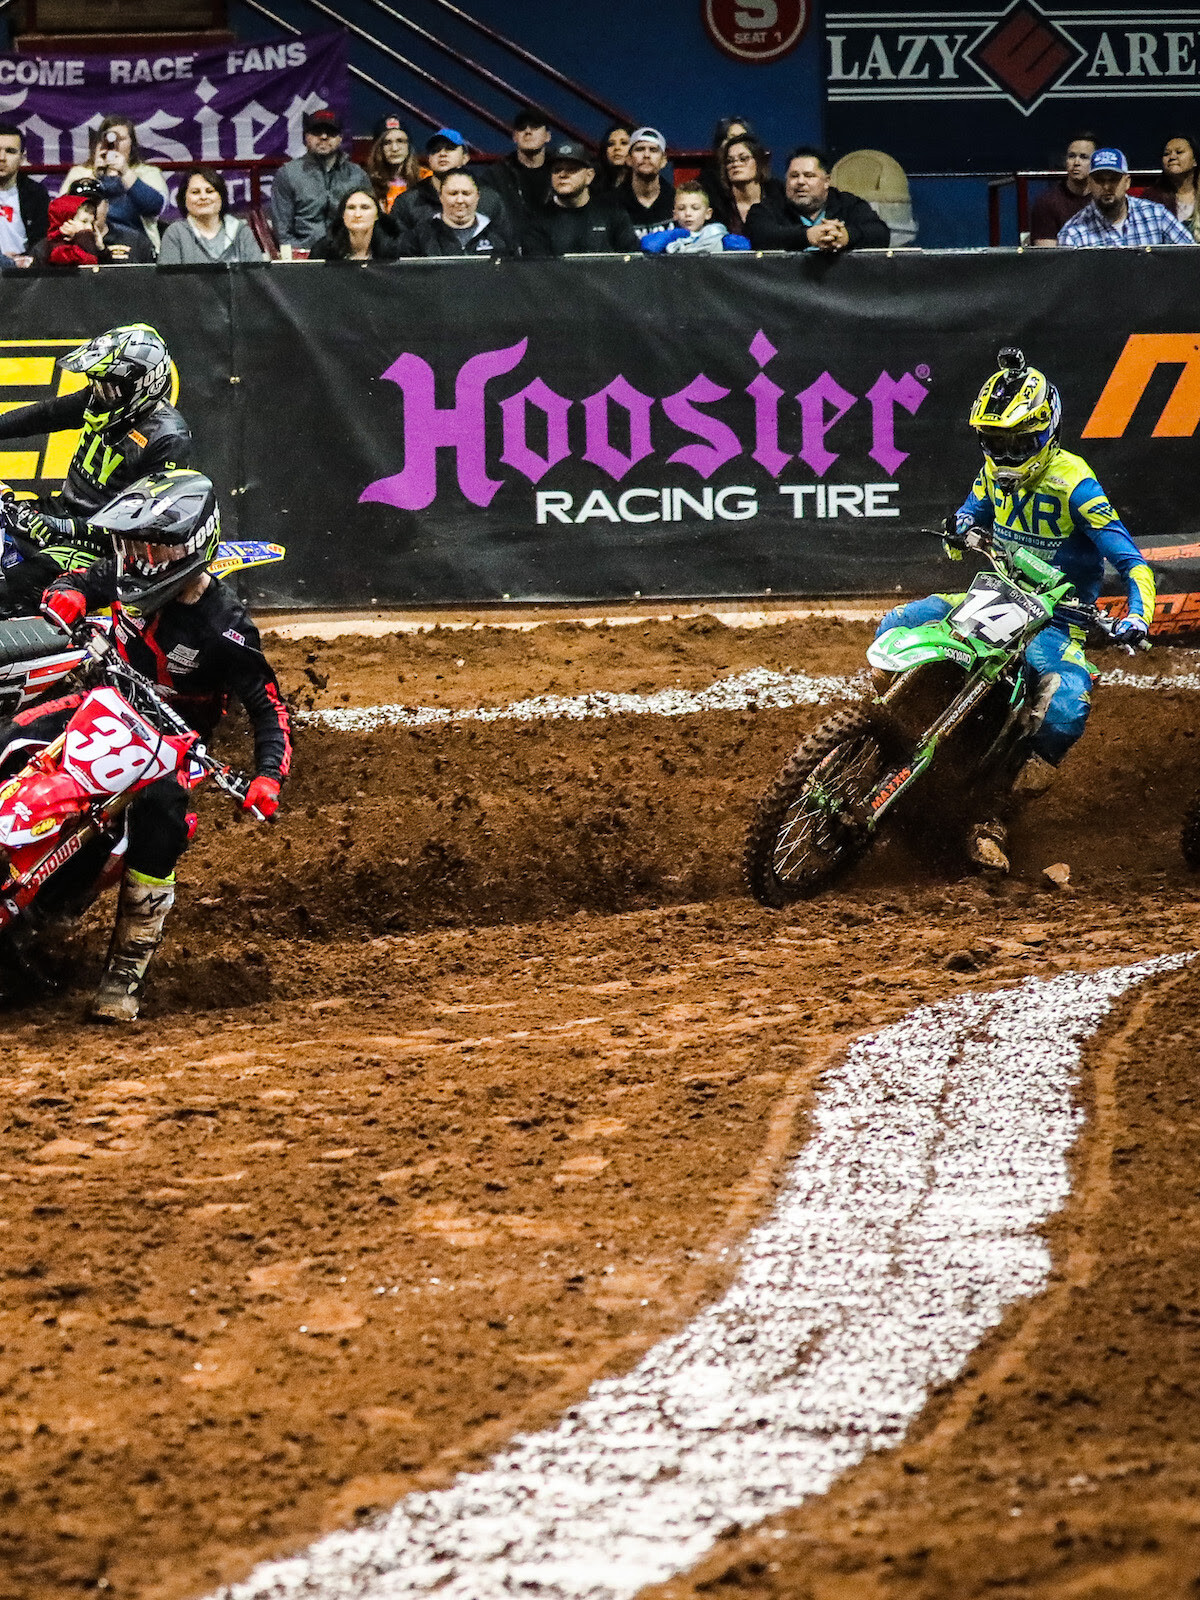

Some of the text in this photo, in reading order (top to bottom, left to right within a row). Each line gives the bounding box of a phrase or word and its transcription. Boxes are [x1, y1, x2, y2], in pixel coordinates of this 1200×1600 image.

[734, 31, 782, 44] SEAT 1
[826, 35, 968, 80] LAZY
[1086, 32, 1199, 77] ARE
[110, 56, 195, 84] RACE
[226, 42, 307, 75] FANS
[358, 328, 930, 511] Hoosier
[535, 483, 900, 524] RACING TIRE
[951, 588, 1035, 643] 14
[66, 715, 160, 793] 38
[871, 767, 912, 809] MAXXIS
